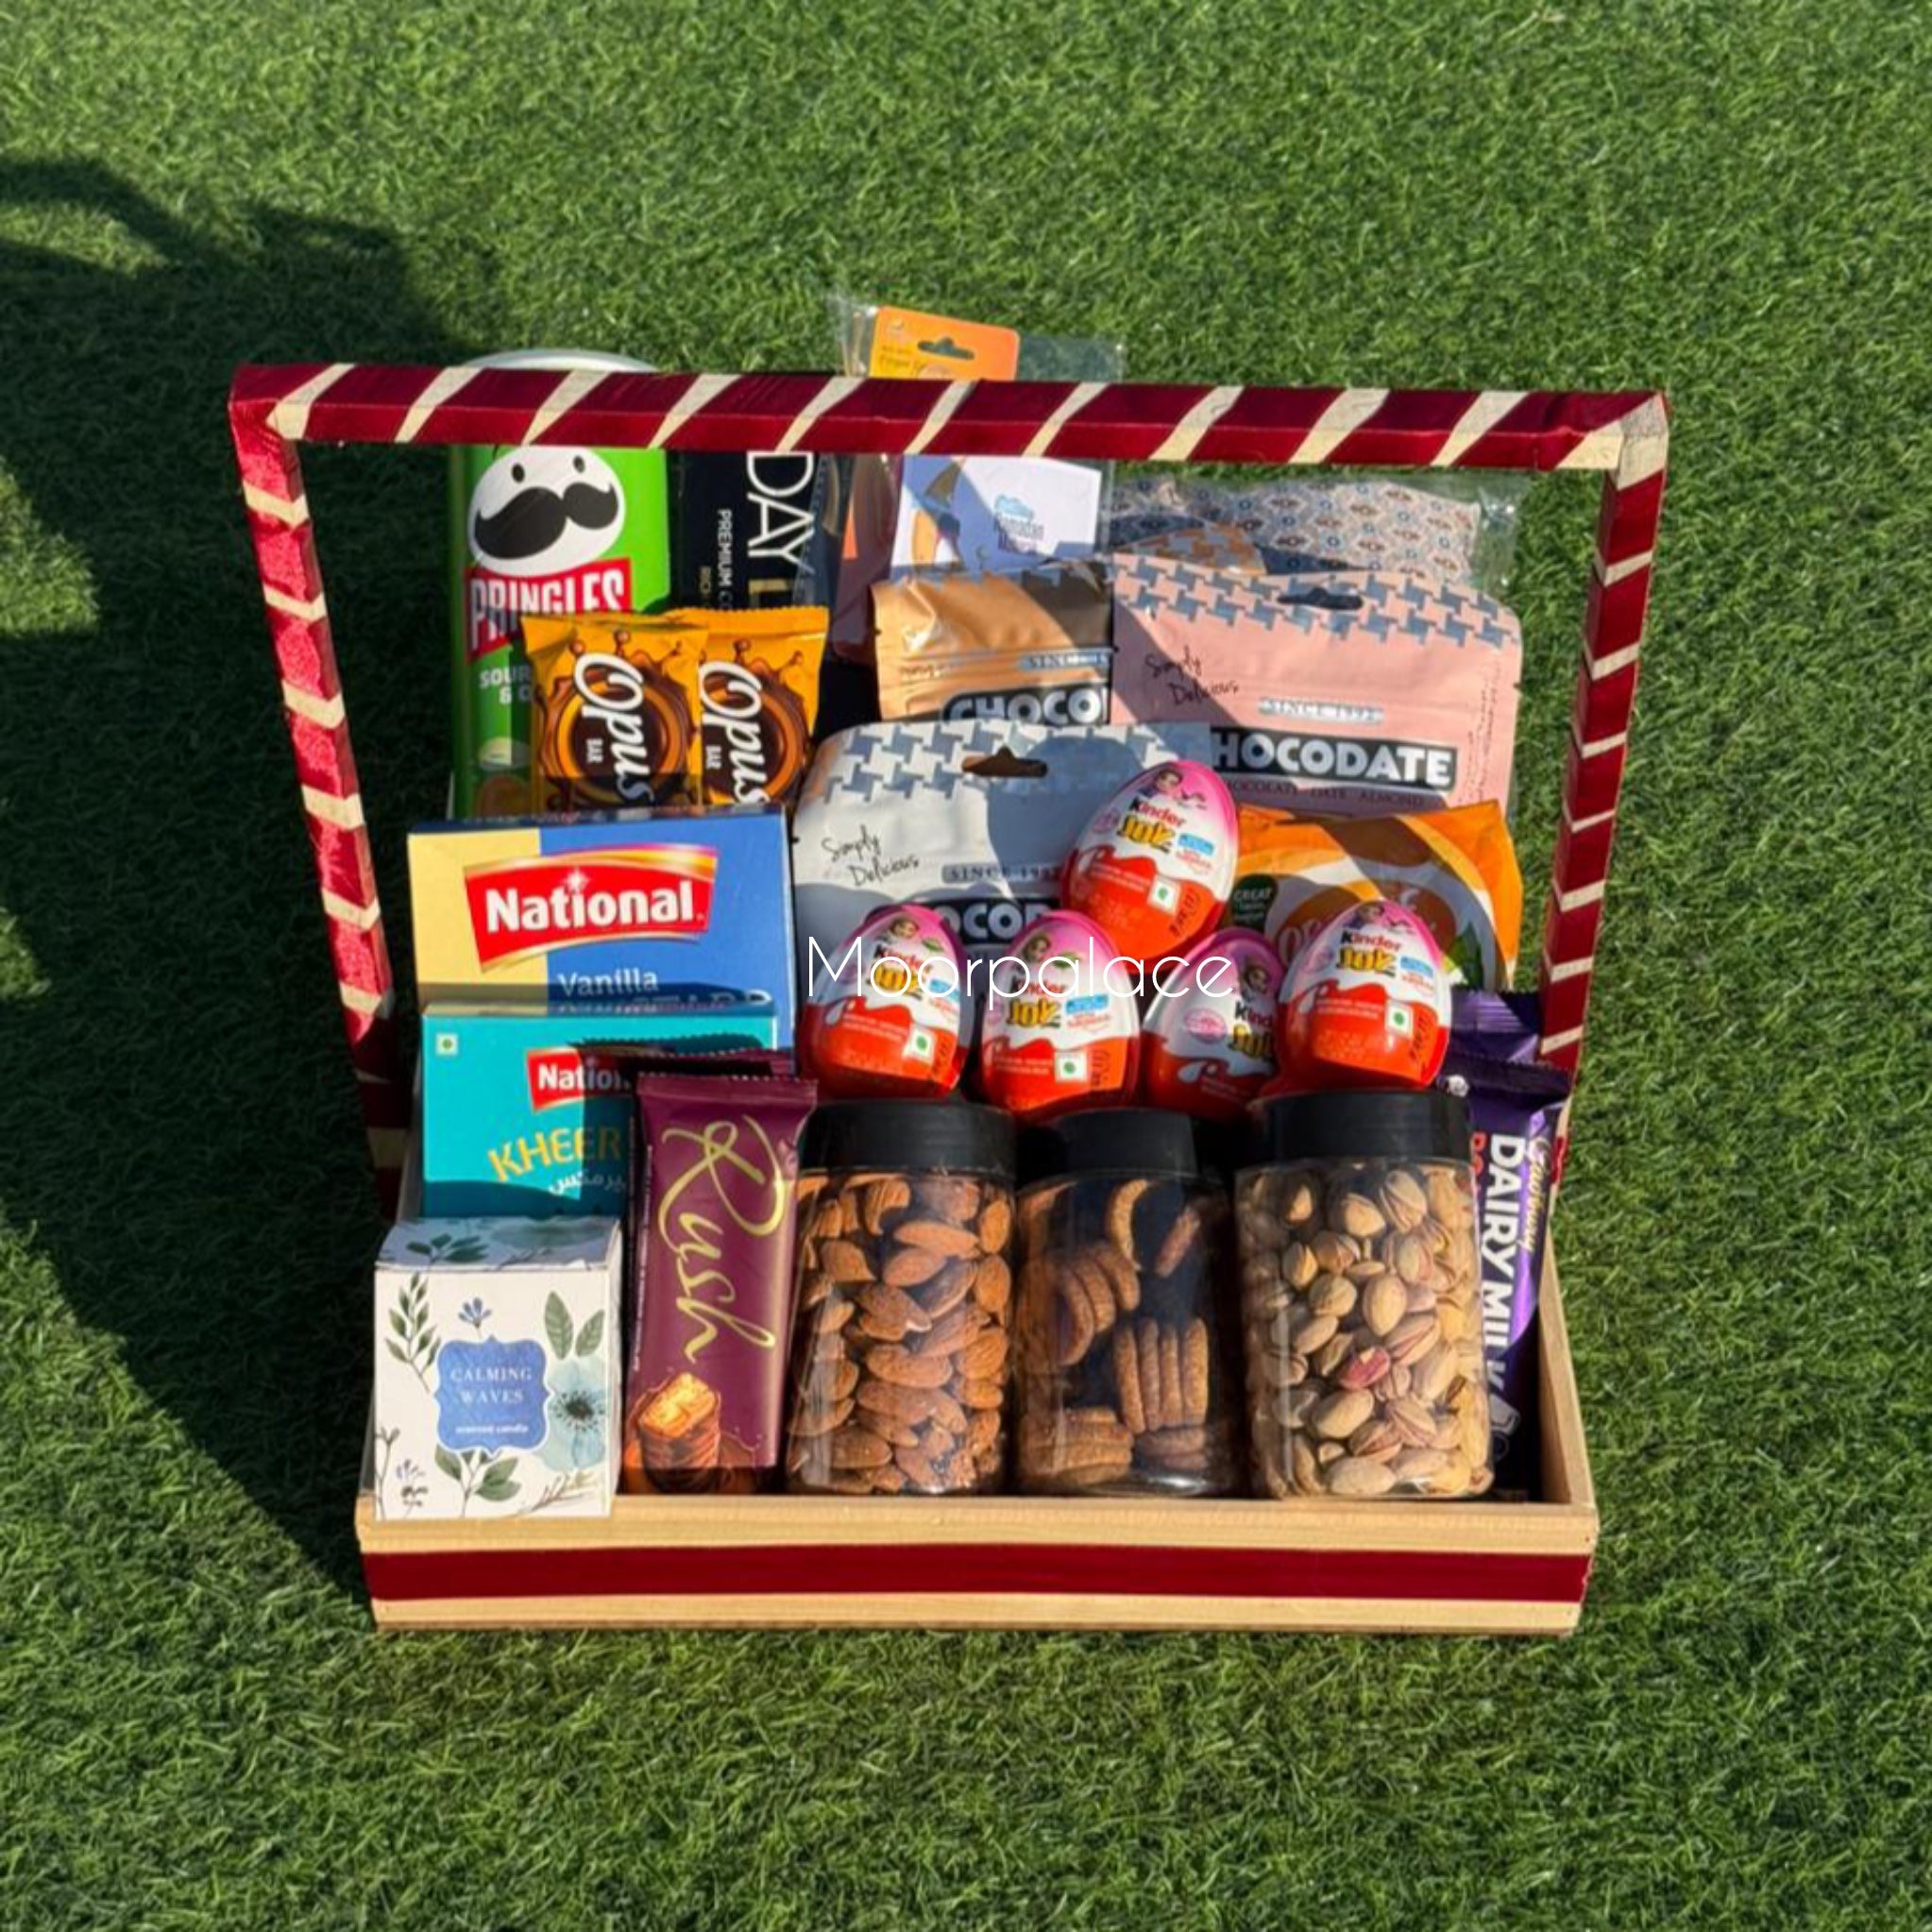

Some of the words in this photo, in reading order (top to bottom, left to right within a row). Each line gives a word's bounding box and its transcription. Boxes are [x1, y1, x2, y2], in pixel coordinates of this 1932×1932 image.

[746, 450, 815, 574] DAY
[717, 508, 733, 586] PREMIUM
[469, 568, 624, 652] PRINGLES
[574, 652, 654, 801] Opus
[699, 661, 771, 803] Opus
[949, 687, 1109, 725] CHOCO
[585, 737, 603, 764] BAR
[705, 745, 722, 771] BAR
[1211, 731, 1452, 787] HOCODATE
[822, 823, 882, 861] Simply
[847, 854, 920, 887] Delicious
[484, 878, 694, 934] National
[557, 968, 659, 996] Vanilla
[487, 1127, 620, 1183] KHEER
[1481, 1133, 1527, 1279] DAIRY
[658, 1114, 785, 1364] Rush
[449, 1366, 533, 1382] CALMING
[459, 1389, 525, 1405] WAVES
